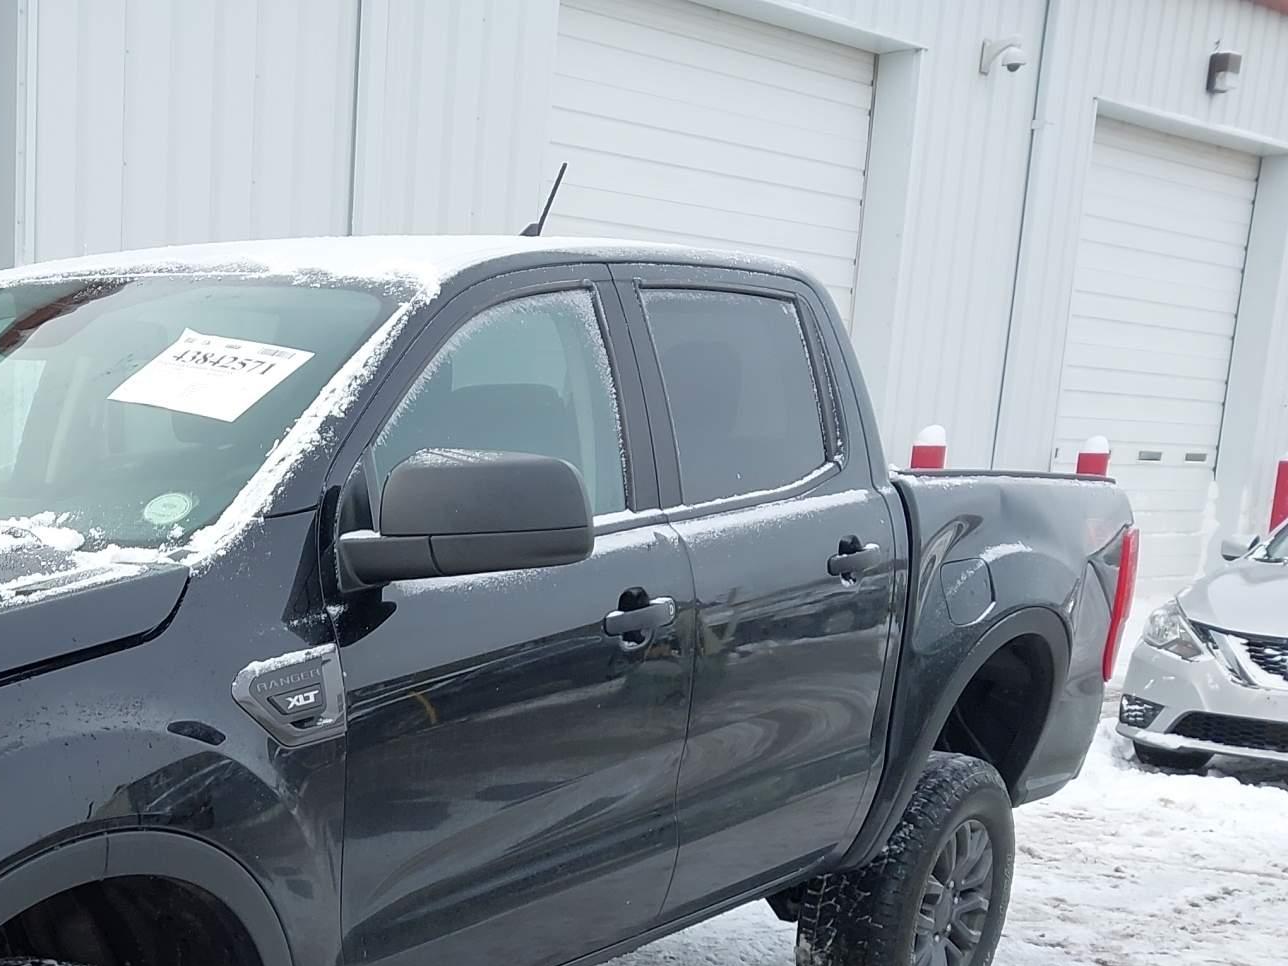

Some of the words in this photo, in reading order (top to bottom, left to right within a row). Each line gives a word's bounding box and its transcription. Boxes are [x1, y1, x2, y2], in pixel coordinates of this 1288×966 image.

[173, 349, 276, 375] 43842571
[256, 668, 320, 692] RANGER
[285, 690, 319, 709] XLT
